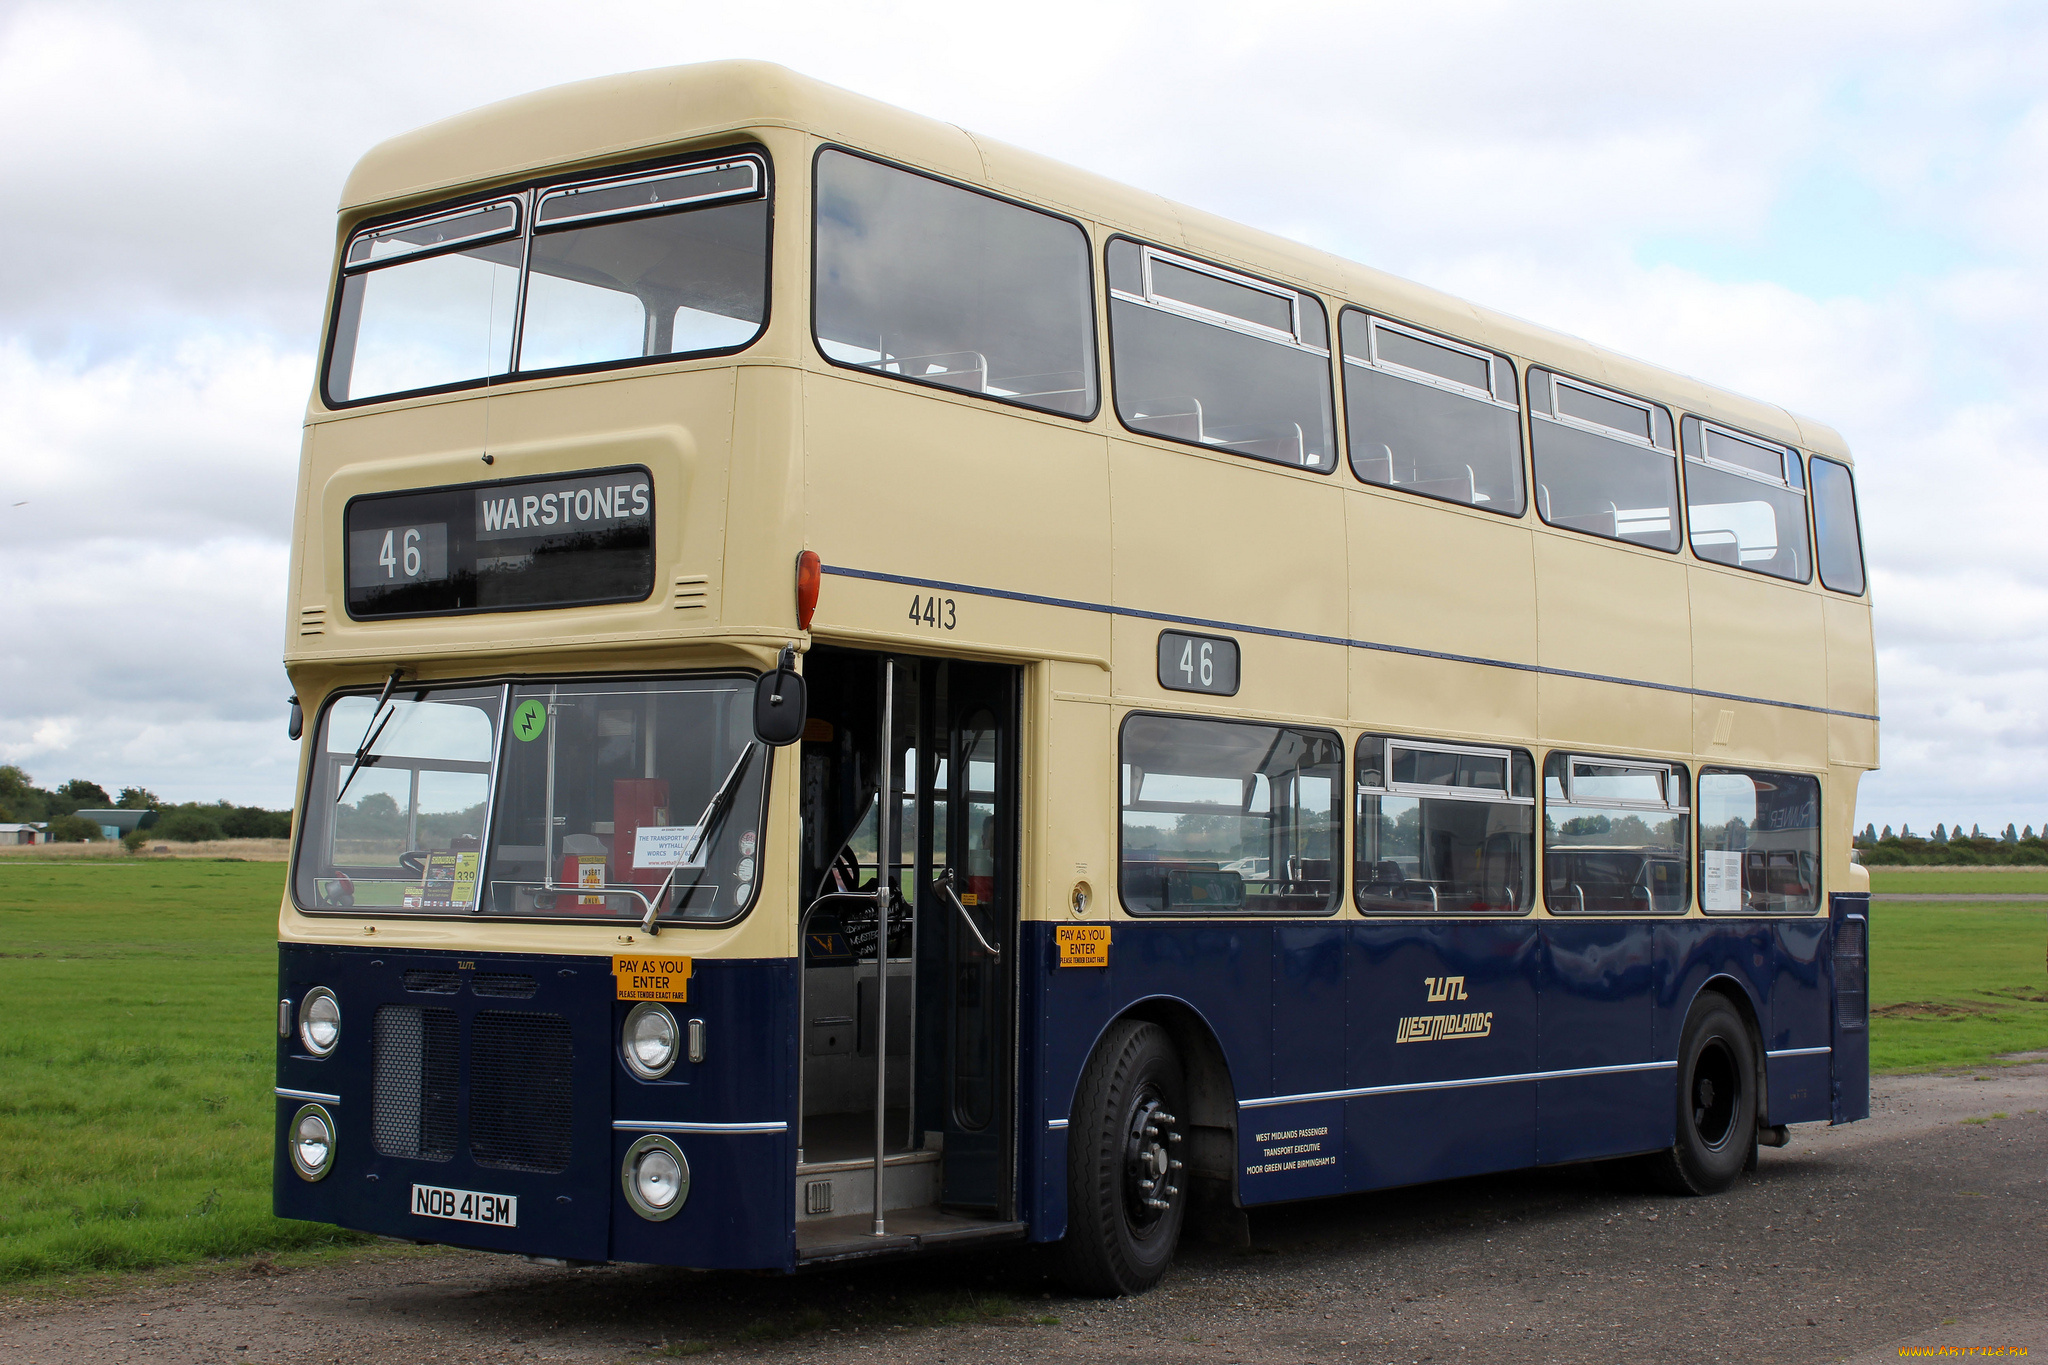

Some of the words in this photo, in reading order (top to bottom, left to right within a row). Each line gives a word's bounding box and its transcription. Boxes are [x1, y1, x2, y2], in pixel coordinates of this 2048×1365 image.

[483, 483, 649, 532] WARSTONES
[379, 528, 422, 578] 46
[908, 594, 957, 630] 4413
[1179, 639, 1213, 686] 46
[457, 871, 475, 883] 339
[1060, 929, 1074, 941] PAY
[1076, 929, 1086, 941] AS
[1088, 929, 1105, 941] YOU
[1070, 943, 1096, 955] ENTER
[619, 960, 639, 973] PAY
[641, 960, 656, 973] AS
[659, 961, 684, 974] YOU
[633, 976, 670, 989] ENTER
[618, 990, 636, 998] PLEASE
[637, 991, 655, 999] TENDER
[655, 991, 671, 999] EXACT
[1255, 1132, 1271, 1142] WEST
[1271, 1129, 1298, 1141] MIDLANDS
[1298, 1126, 1328, 1138] PASSENGER
[1263, 1145, 1294, 1157] TRANSPORT
[1294, 1142, 1321, 1154] EXECUTIVE
[1246, 1165, 1264, 1175] MOOR
[1264, 1163, 1282, 1173] GREEN
[1282, 1160, 1297, 1171] LANE
[1297, 1157, 1330, 1169] BIRMINGHAM
[1330, 1156, 1336, 1165] 13
[416, 1187, 456, 1217] NOB
[460, 1193, 510, 1224] 413M
